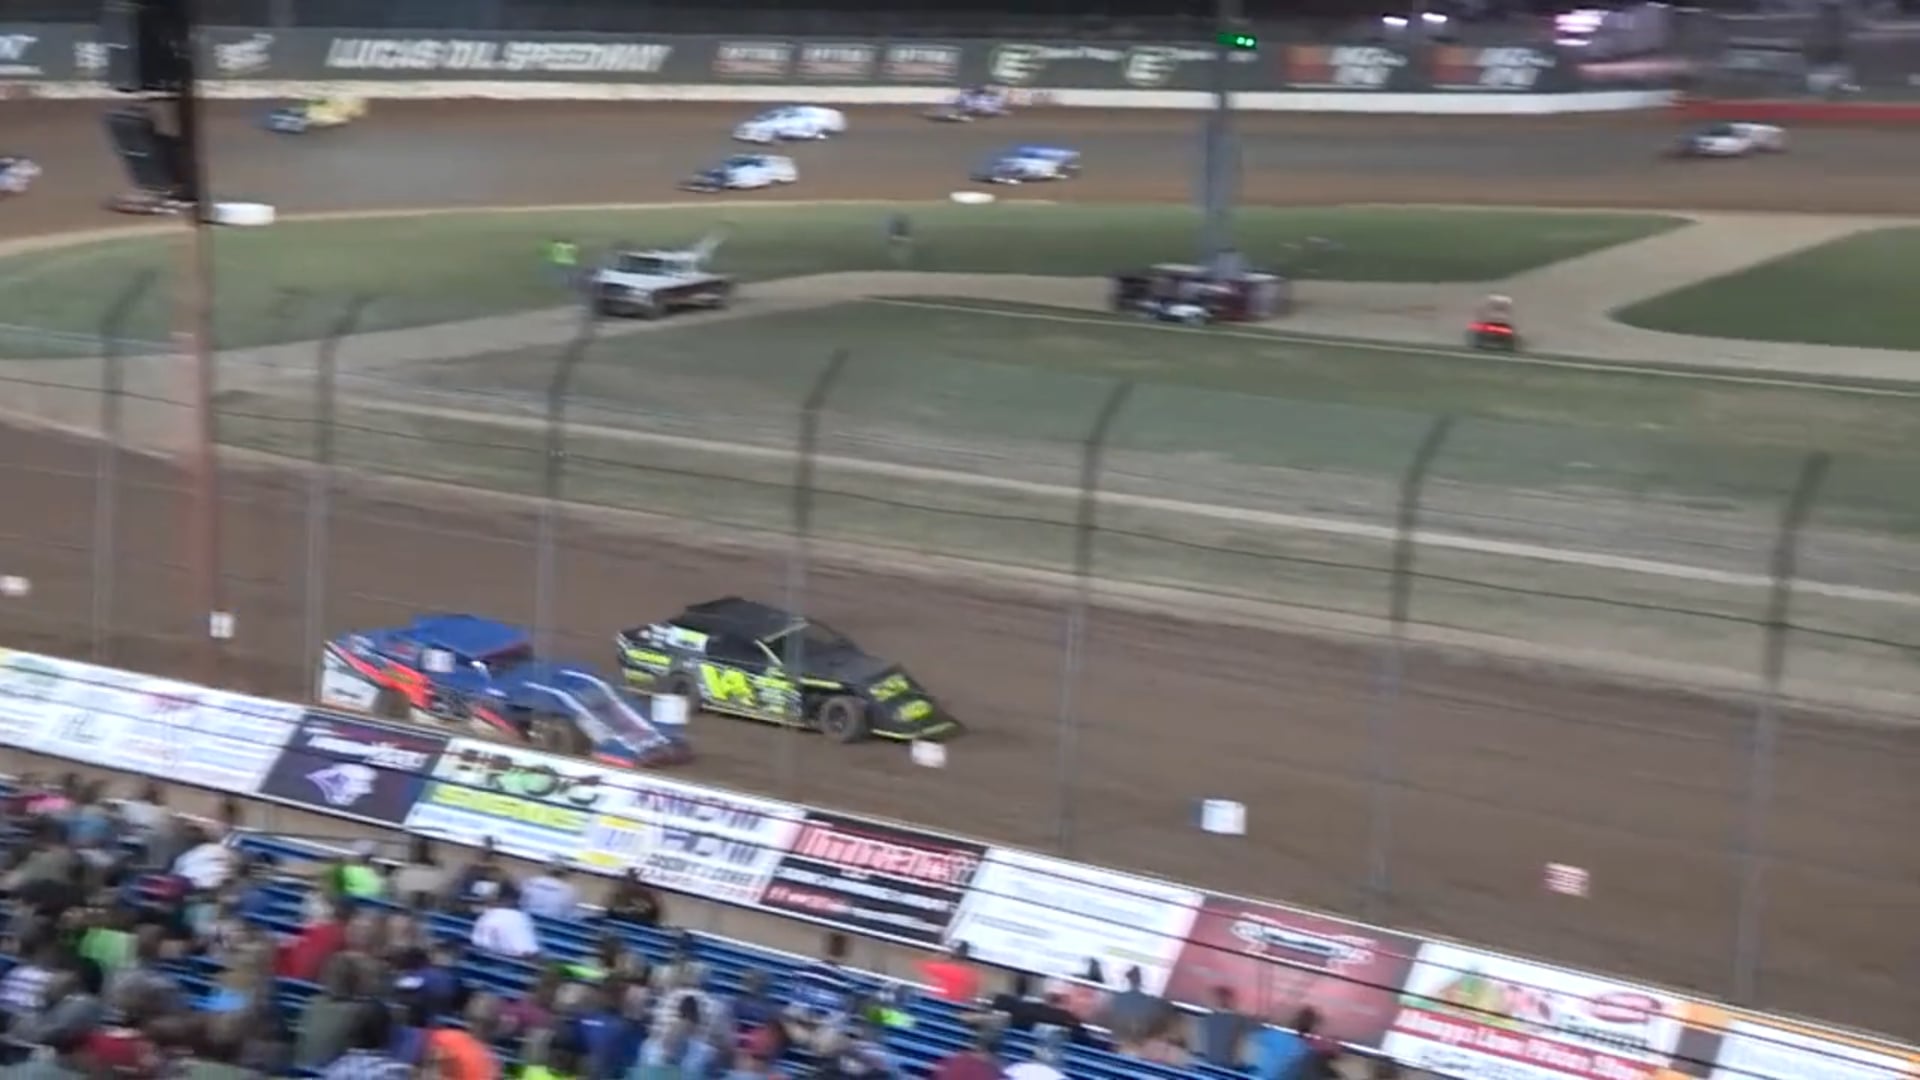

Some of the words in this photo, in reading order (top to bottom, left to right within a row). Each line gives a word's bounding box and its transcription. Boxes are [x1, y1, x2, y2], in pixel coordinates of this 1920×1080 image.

[325, 37, 446, 70] LUCAS
[441, 40, 499, 71] OIL
[498, 40, 672, 73] SPEEDWAY
